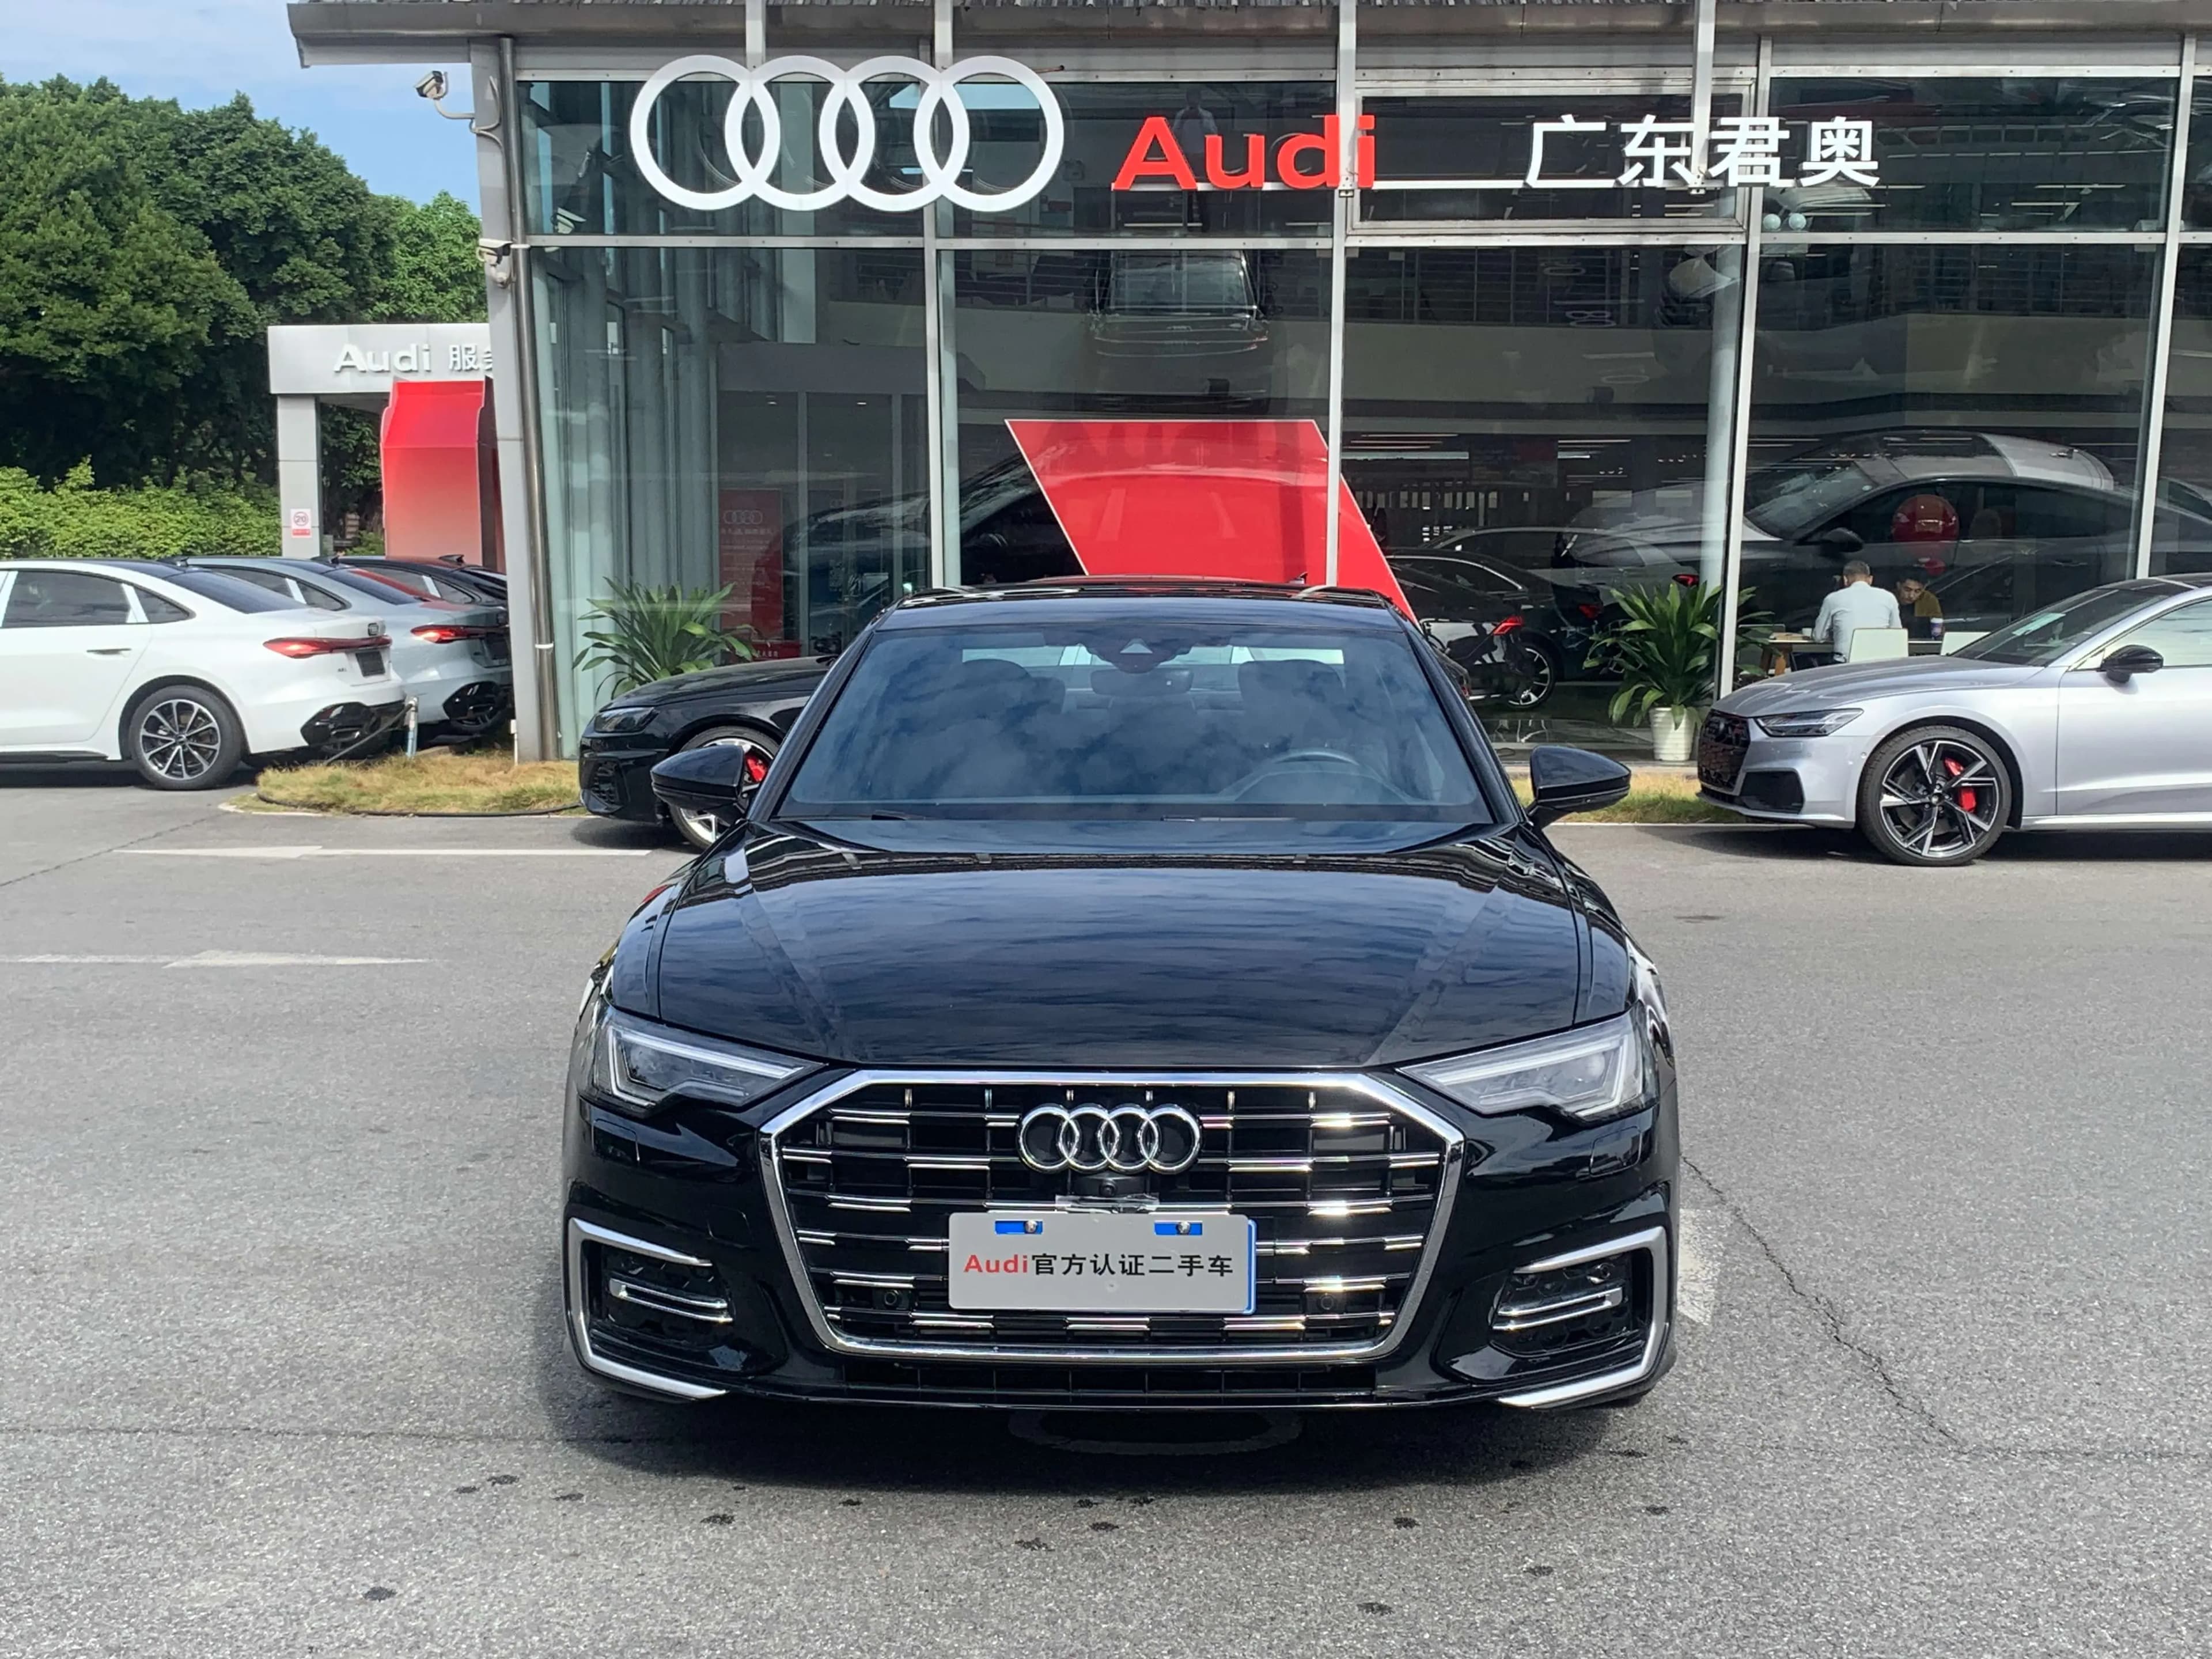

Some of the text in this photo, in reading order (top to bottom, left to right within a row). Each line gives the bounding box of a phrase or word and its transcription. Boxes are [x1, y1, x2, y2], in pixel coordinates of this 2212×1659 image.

[1113, 114, 1880, 190] Audi 广东君奥
[334, 344, 431, 373] Audi
